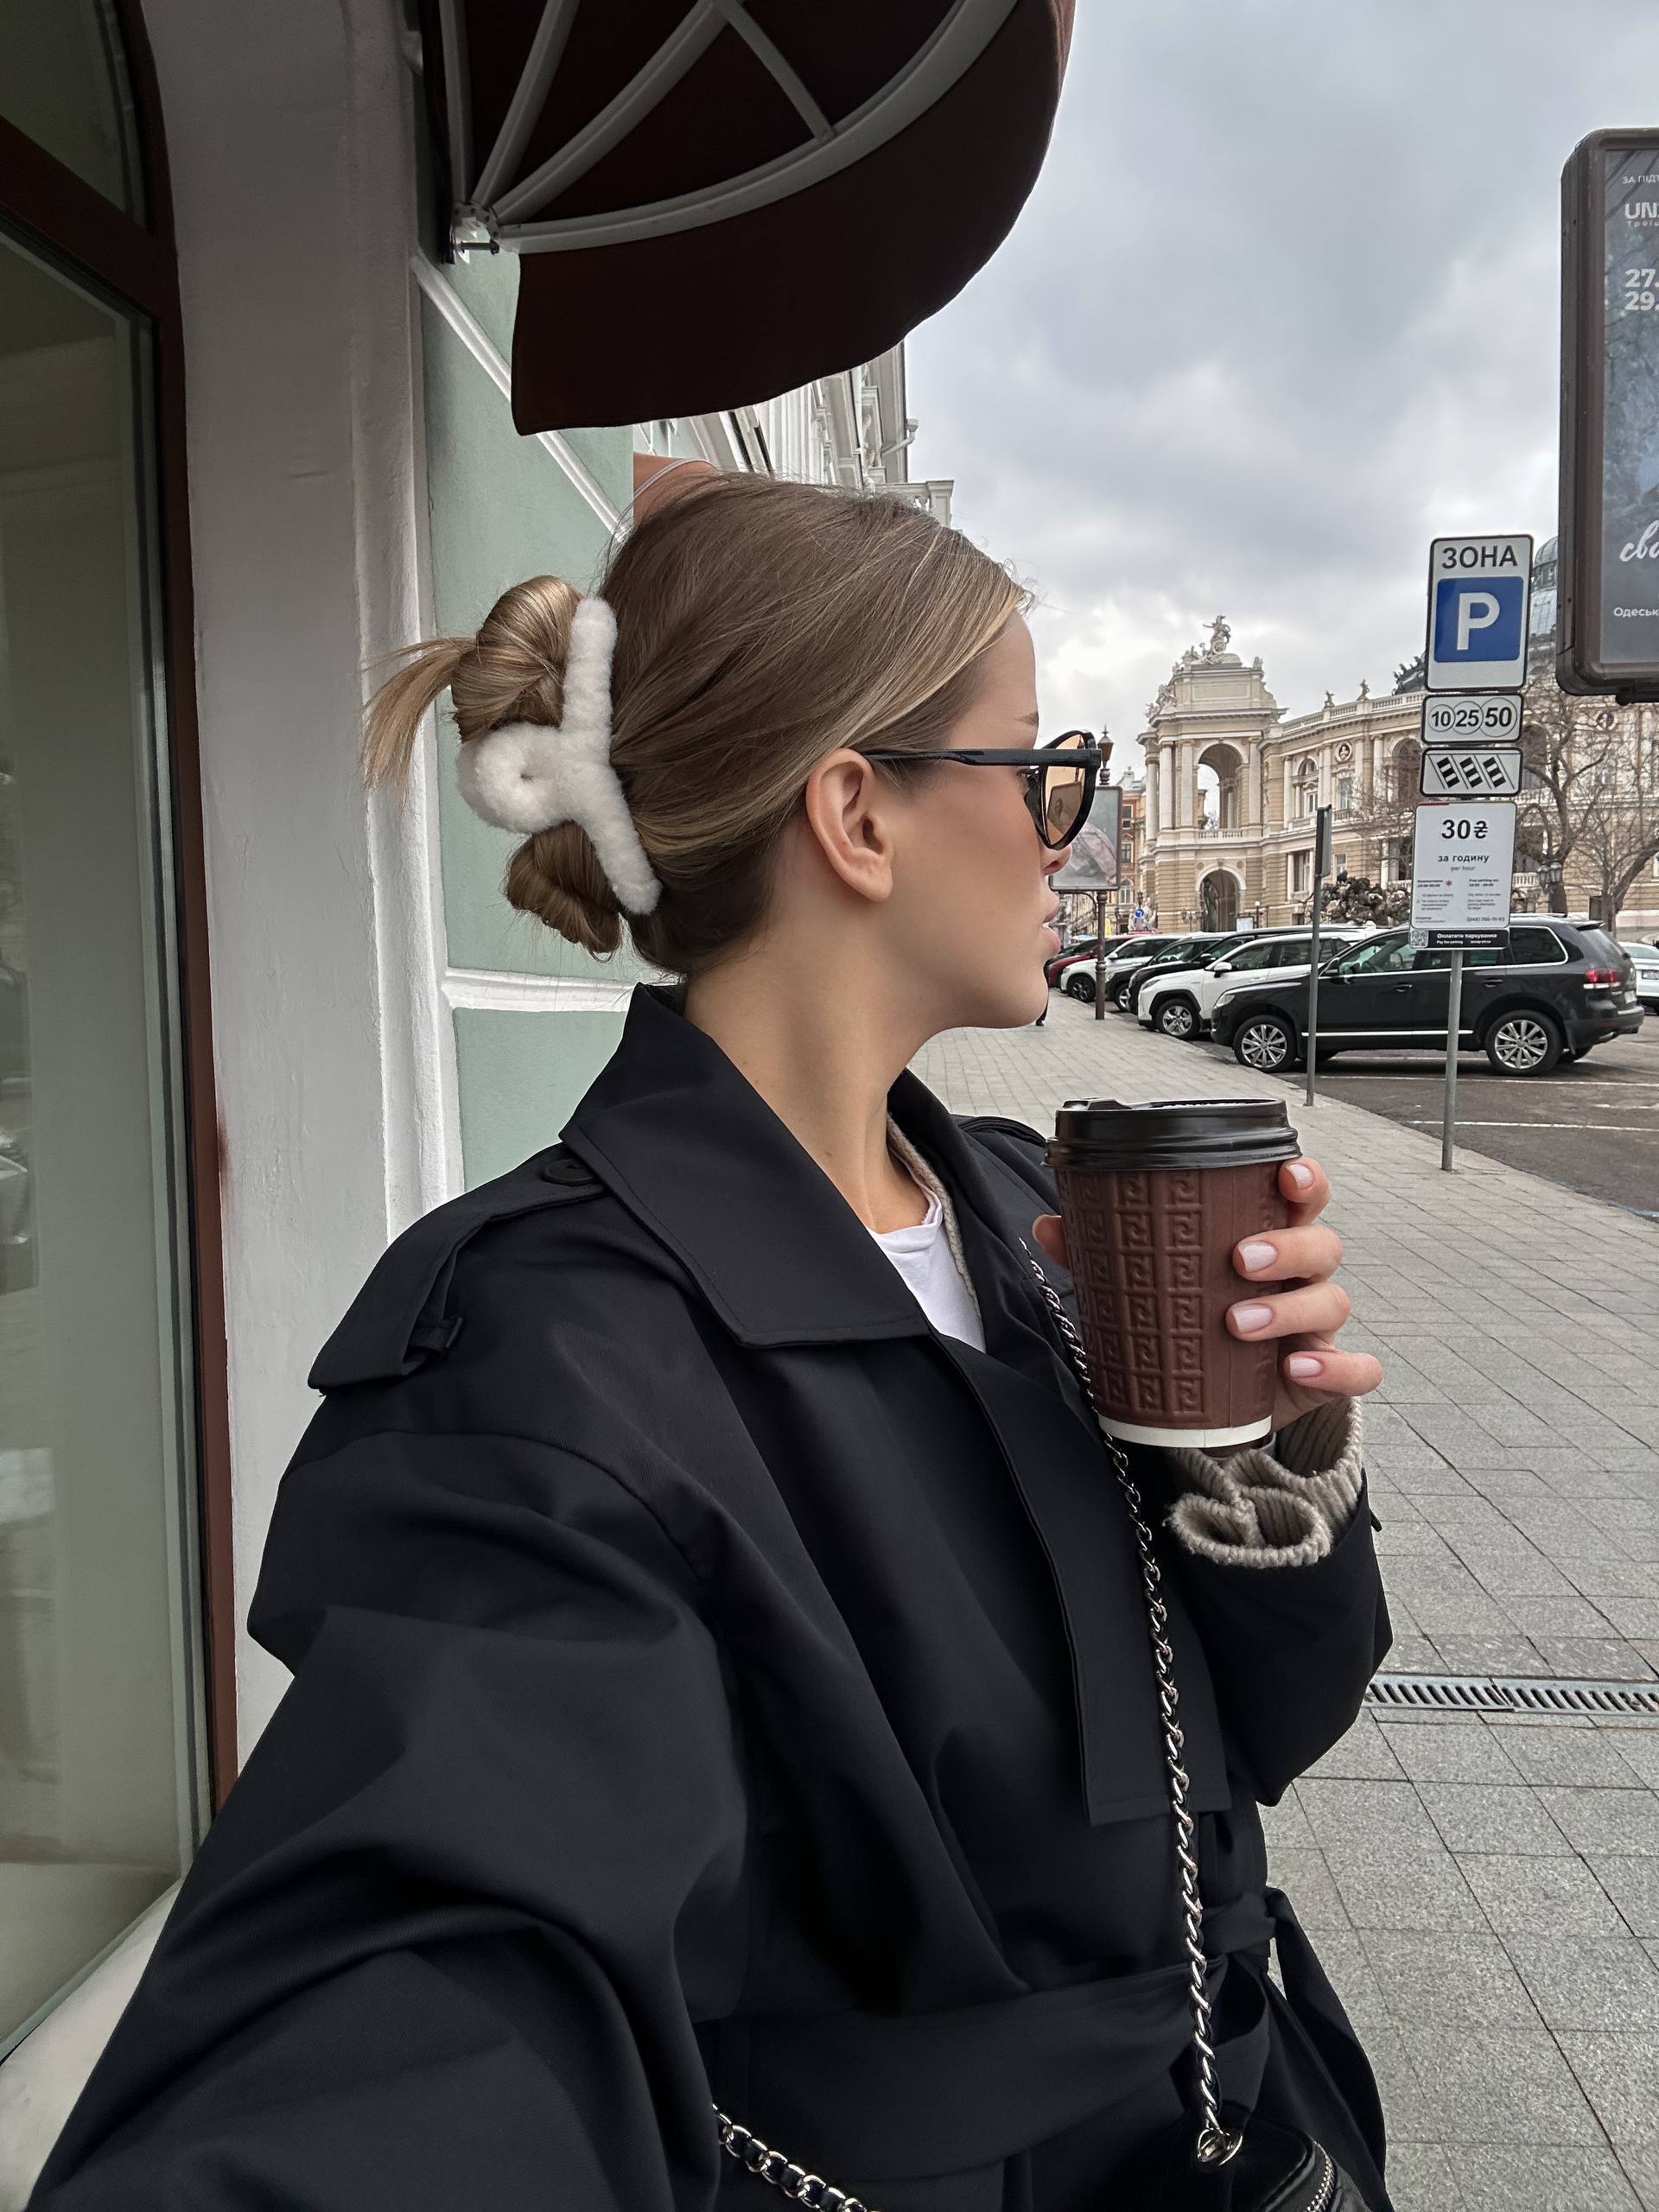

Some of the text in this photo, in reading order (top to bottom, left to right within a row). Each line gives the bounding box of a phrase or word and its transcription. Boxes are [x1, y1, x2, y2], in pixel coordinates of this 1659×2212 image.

[1624, 201, 1659, 219] UN
[1441, 544, 1518, 569] ЗОНА
[1456, 592, 1500, 651] P
[1431, 707, 1512, 728] 10 25 50
[1452, 855, 1490, 863] годину
